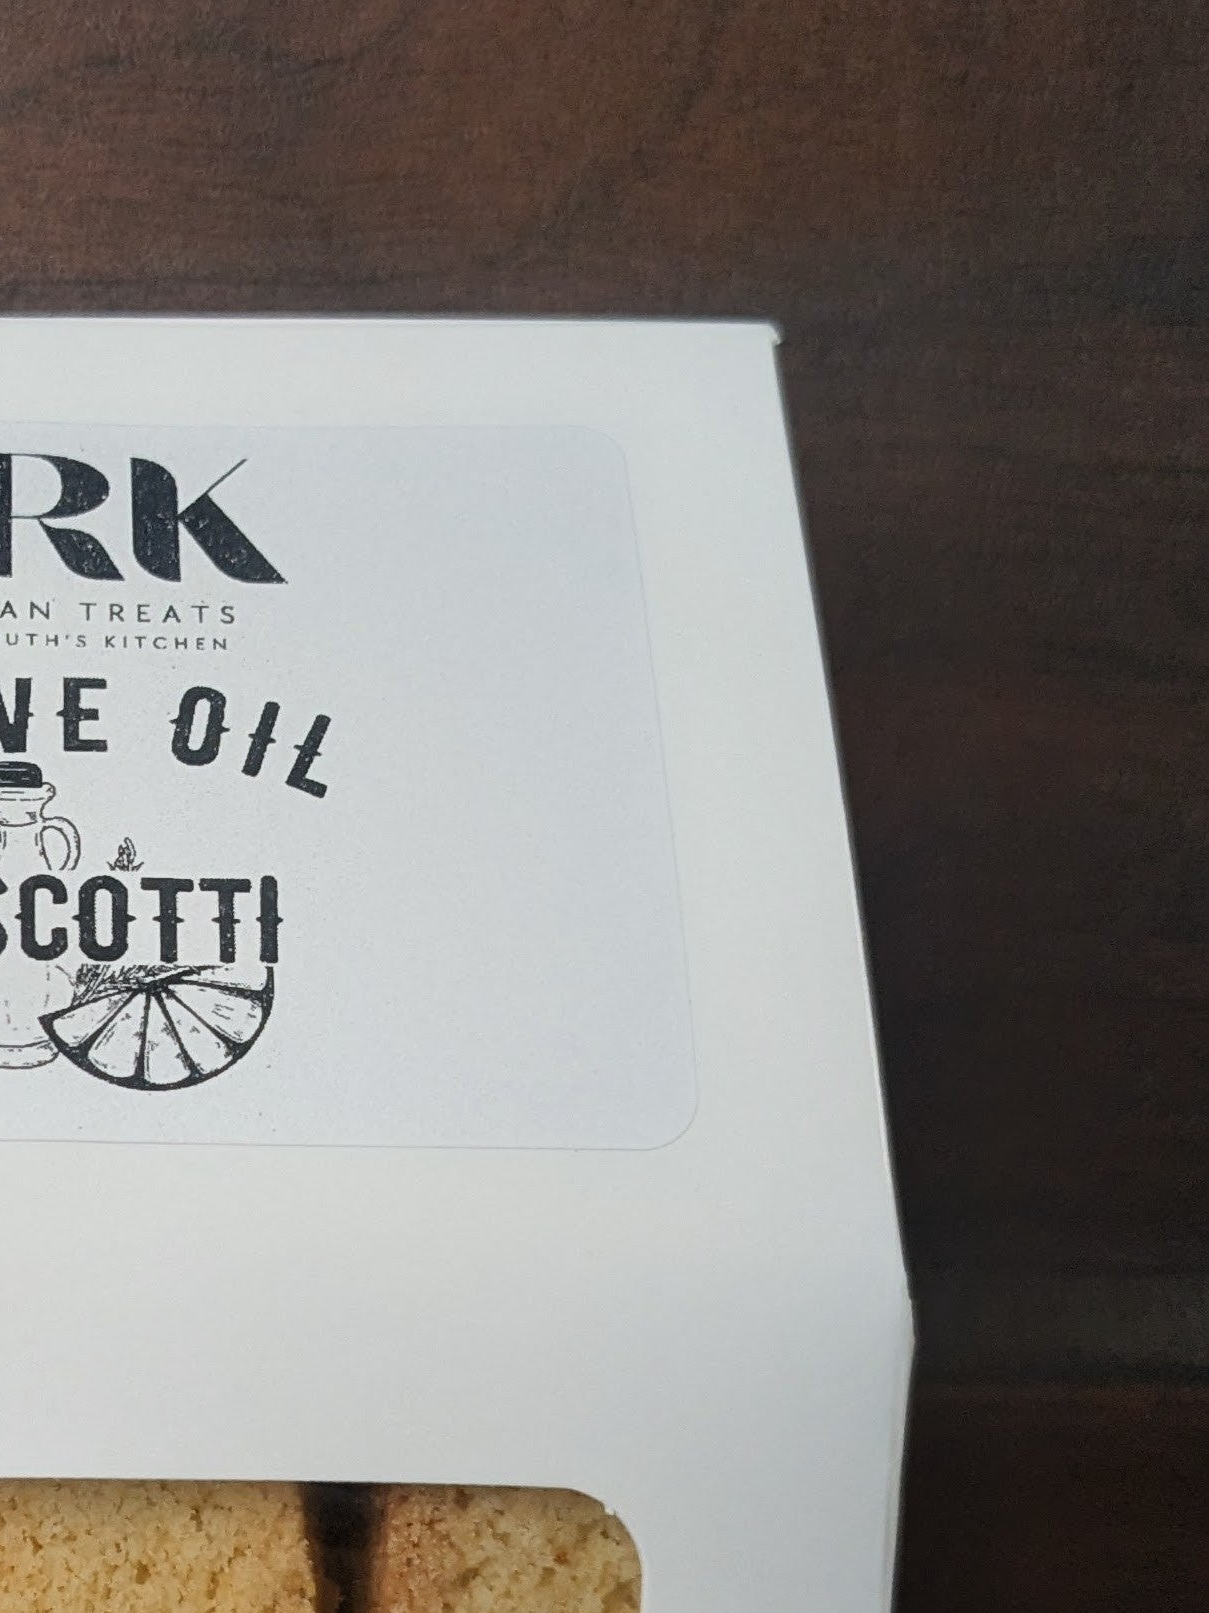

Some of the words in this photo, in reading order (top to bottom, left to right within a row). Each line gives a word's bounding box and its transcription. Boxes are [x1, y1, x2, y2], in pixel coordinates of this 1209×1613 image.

[80, 602, 236, 625] TREATS
[103, 634, 228, 651] KITCHEN
[169, 686, 331, 798] OIL
